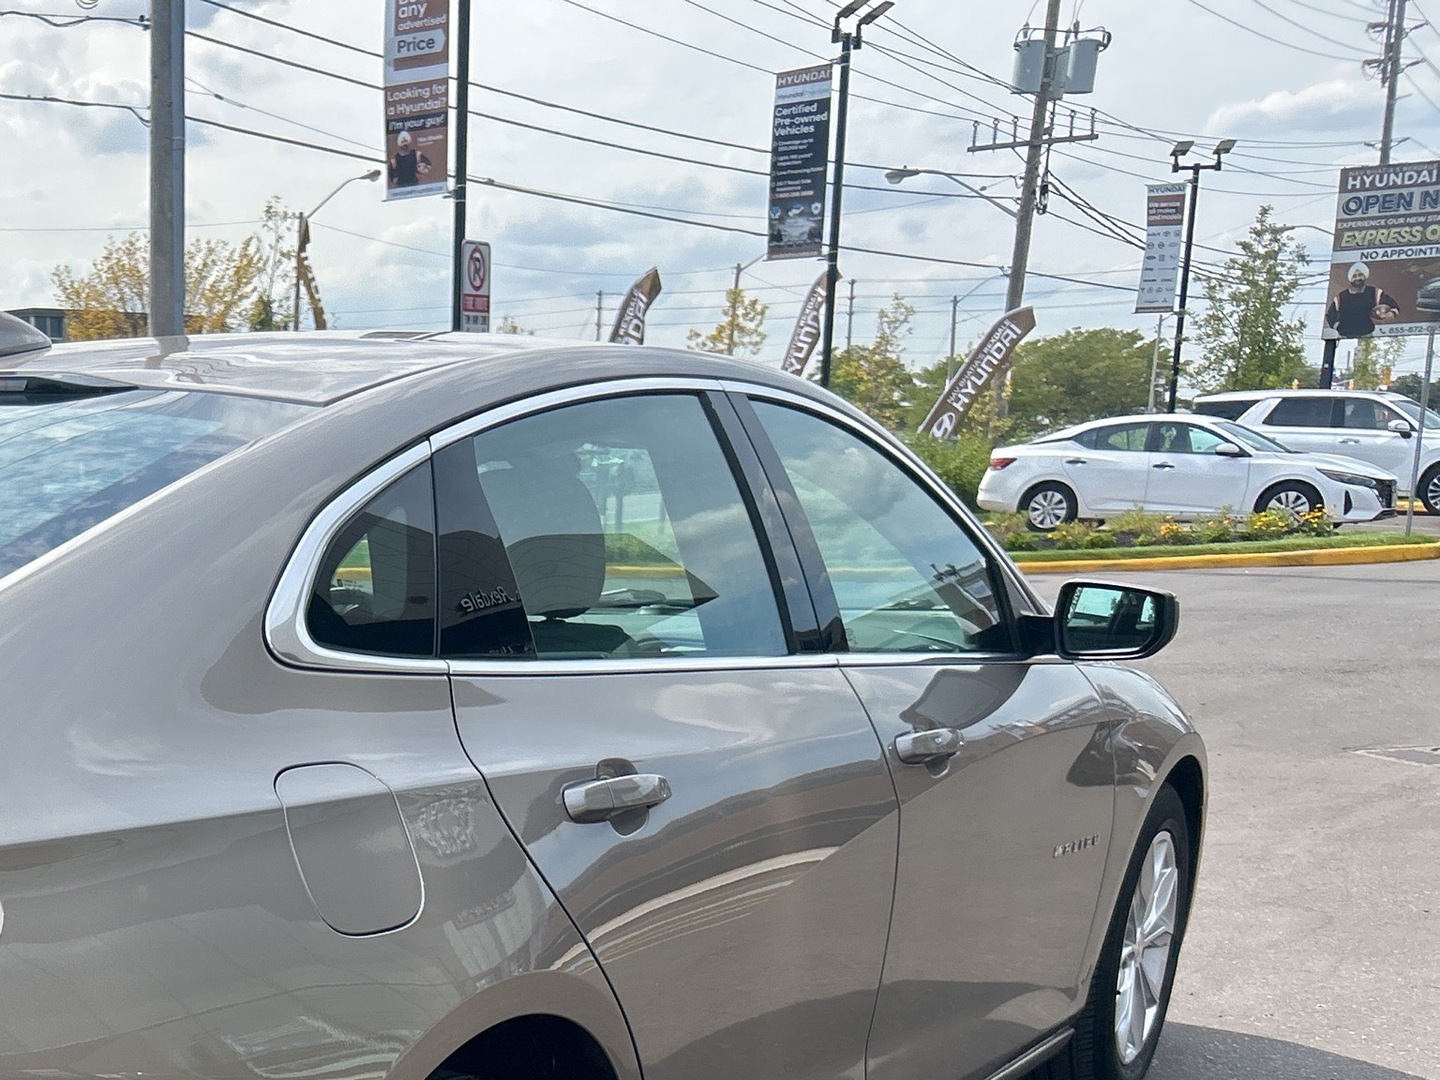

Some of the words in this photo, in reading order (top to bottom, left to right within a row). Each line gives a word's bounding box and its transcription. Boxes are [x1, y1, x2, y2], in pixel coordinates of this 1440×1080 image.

[398, 3, 427, 18] any
[397, 13, 447, 31] advertised
[397, 36, 435, 53] Price
[777, 69, 832, 86] HYUNDAI
[387, 86, 430, 101] Looking
[432, 84, 447, 95] for
[387, 107, 395, 115] a
[775, 103, 817, 117] Certified
[404, 119, 425, 131] your
[774, 111, 828, 127] Pre-owned
[773, 125, 815, 137] Vehicles
[1347, 169, 1438, 189] HYUNDAI
[1149, 185, 1185, 194] HYUNDAI
[1342, 191, 1414, 215] OPEN
[1337, 219, 1386, 229] EXPERIENCE
[1387, 218, 1405, 226] OUR
[1341, 225, 1423, 247] EXPRESS
[1360, 251, 1378, 260] NO
[952, 323, 1021, 412] HYUNDAI
